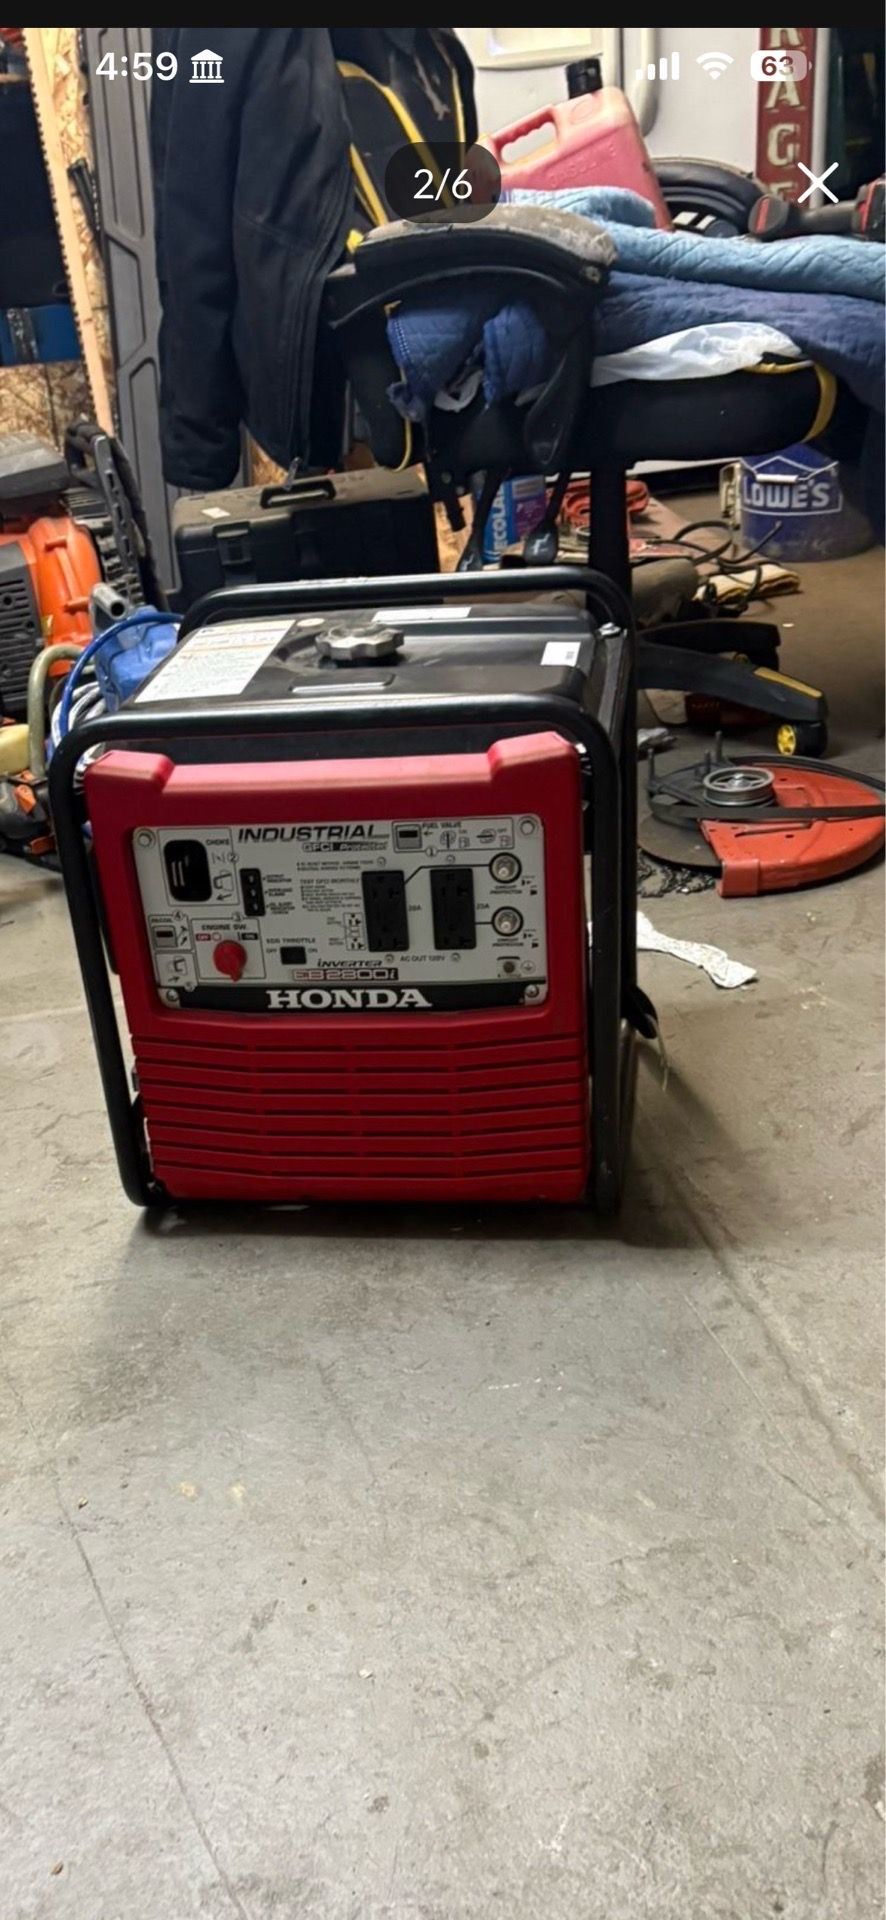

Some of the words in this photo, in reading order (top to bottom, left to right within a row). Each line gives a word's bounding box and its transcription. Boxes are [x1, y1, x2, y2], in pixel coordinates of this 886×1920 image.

[743, 476, 830, 508] LOWE'S
[238, 825, 389, 843] INDUSTRIAL
[206, 838, 229, 846] CHOKE
[303, 842, 333, 852] GFCI
[294, 968, 397, 980] EB2800i
[266, 989, 432, 1009] HONDA
